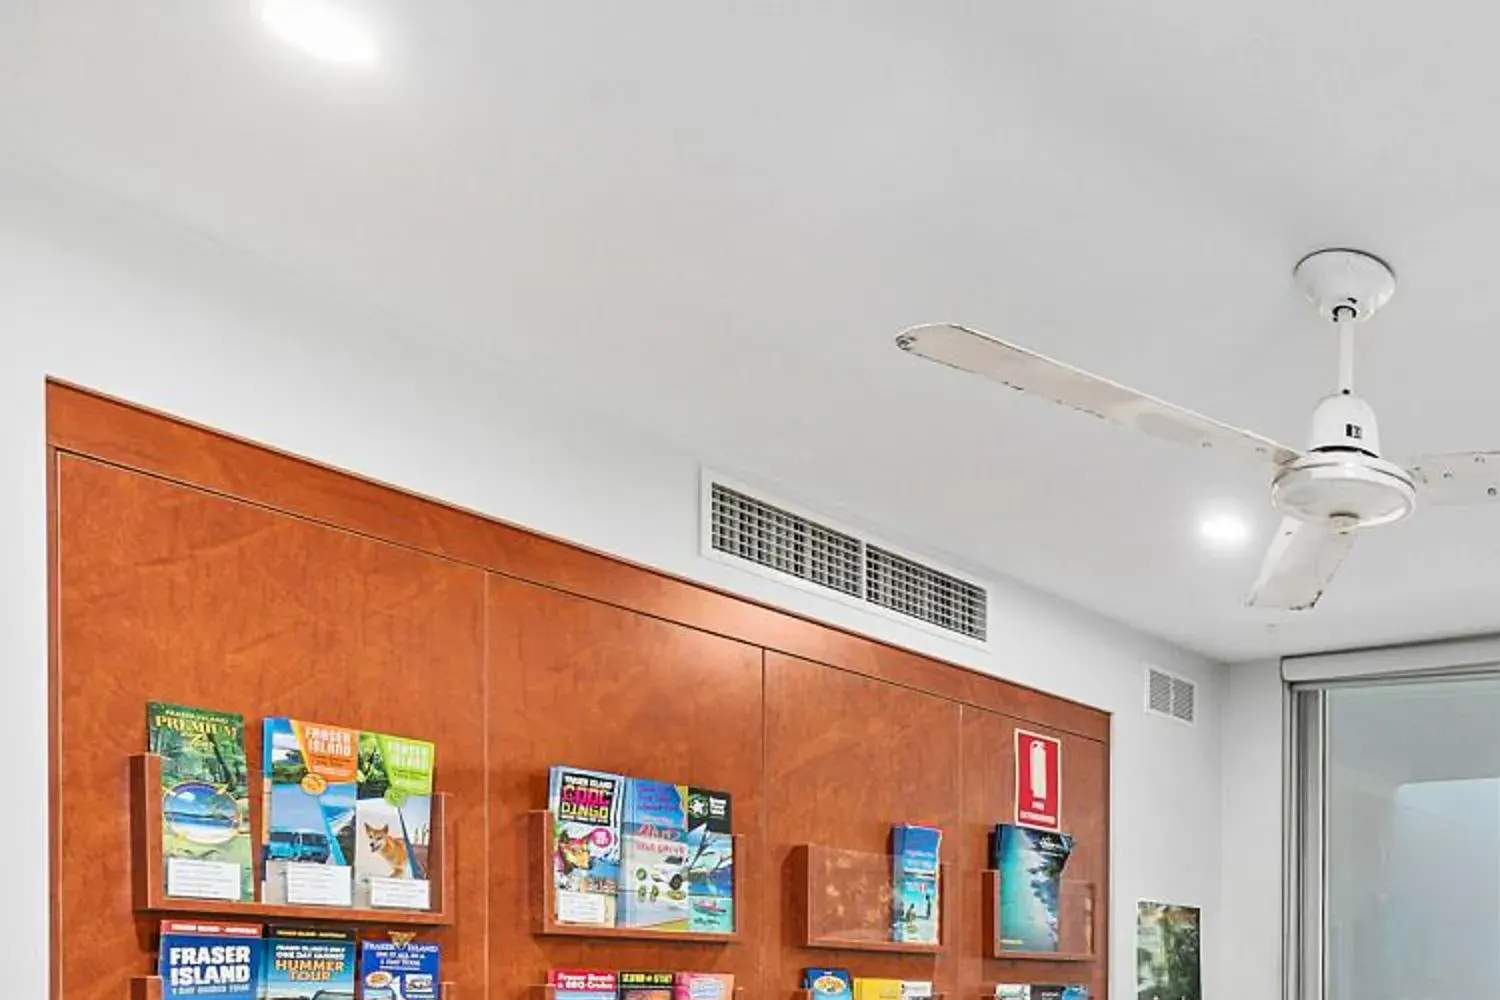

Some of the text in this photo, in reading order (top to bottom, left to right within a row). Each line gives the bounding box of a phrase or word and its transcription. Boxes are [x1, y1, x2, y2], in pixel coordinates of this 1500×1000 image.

[562, 802, 609, 818] DINGO
[169, 945, 250, 966] FRASER
[275, 959, 345, 972] HUMMER
[170, 965, 250, 986] ISLAND
